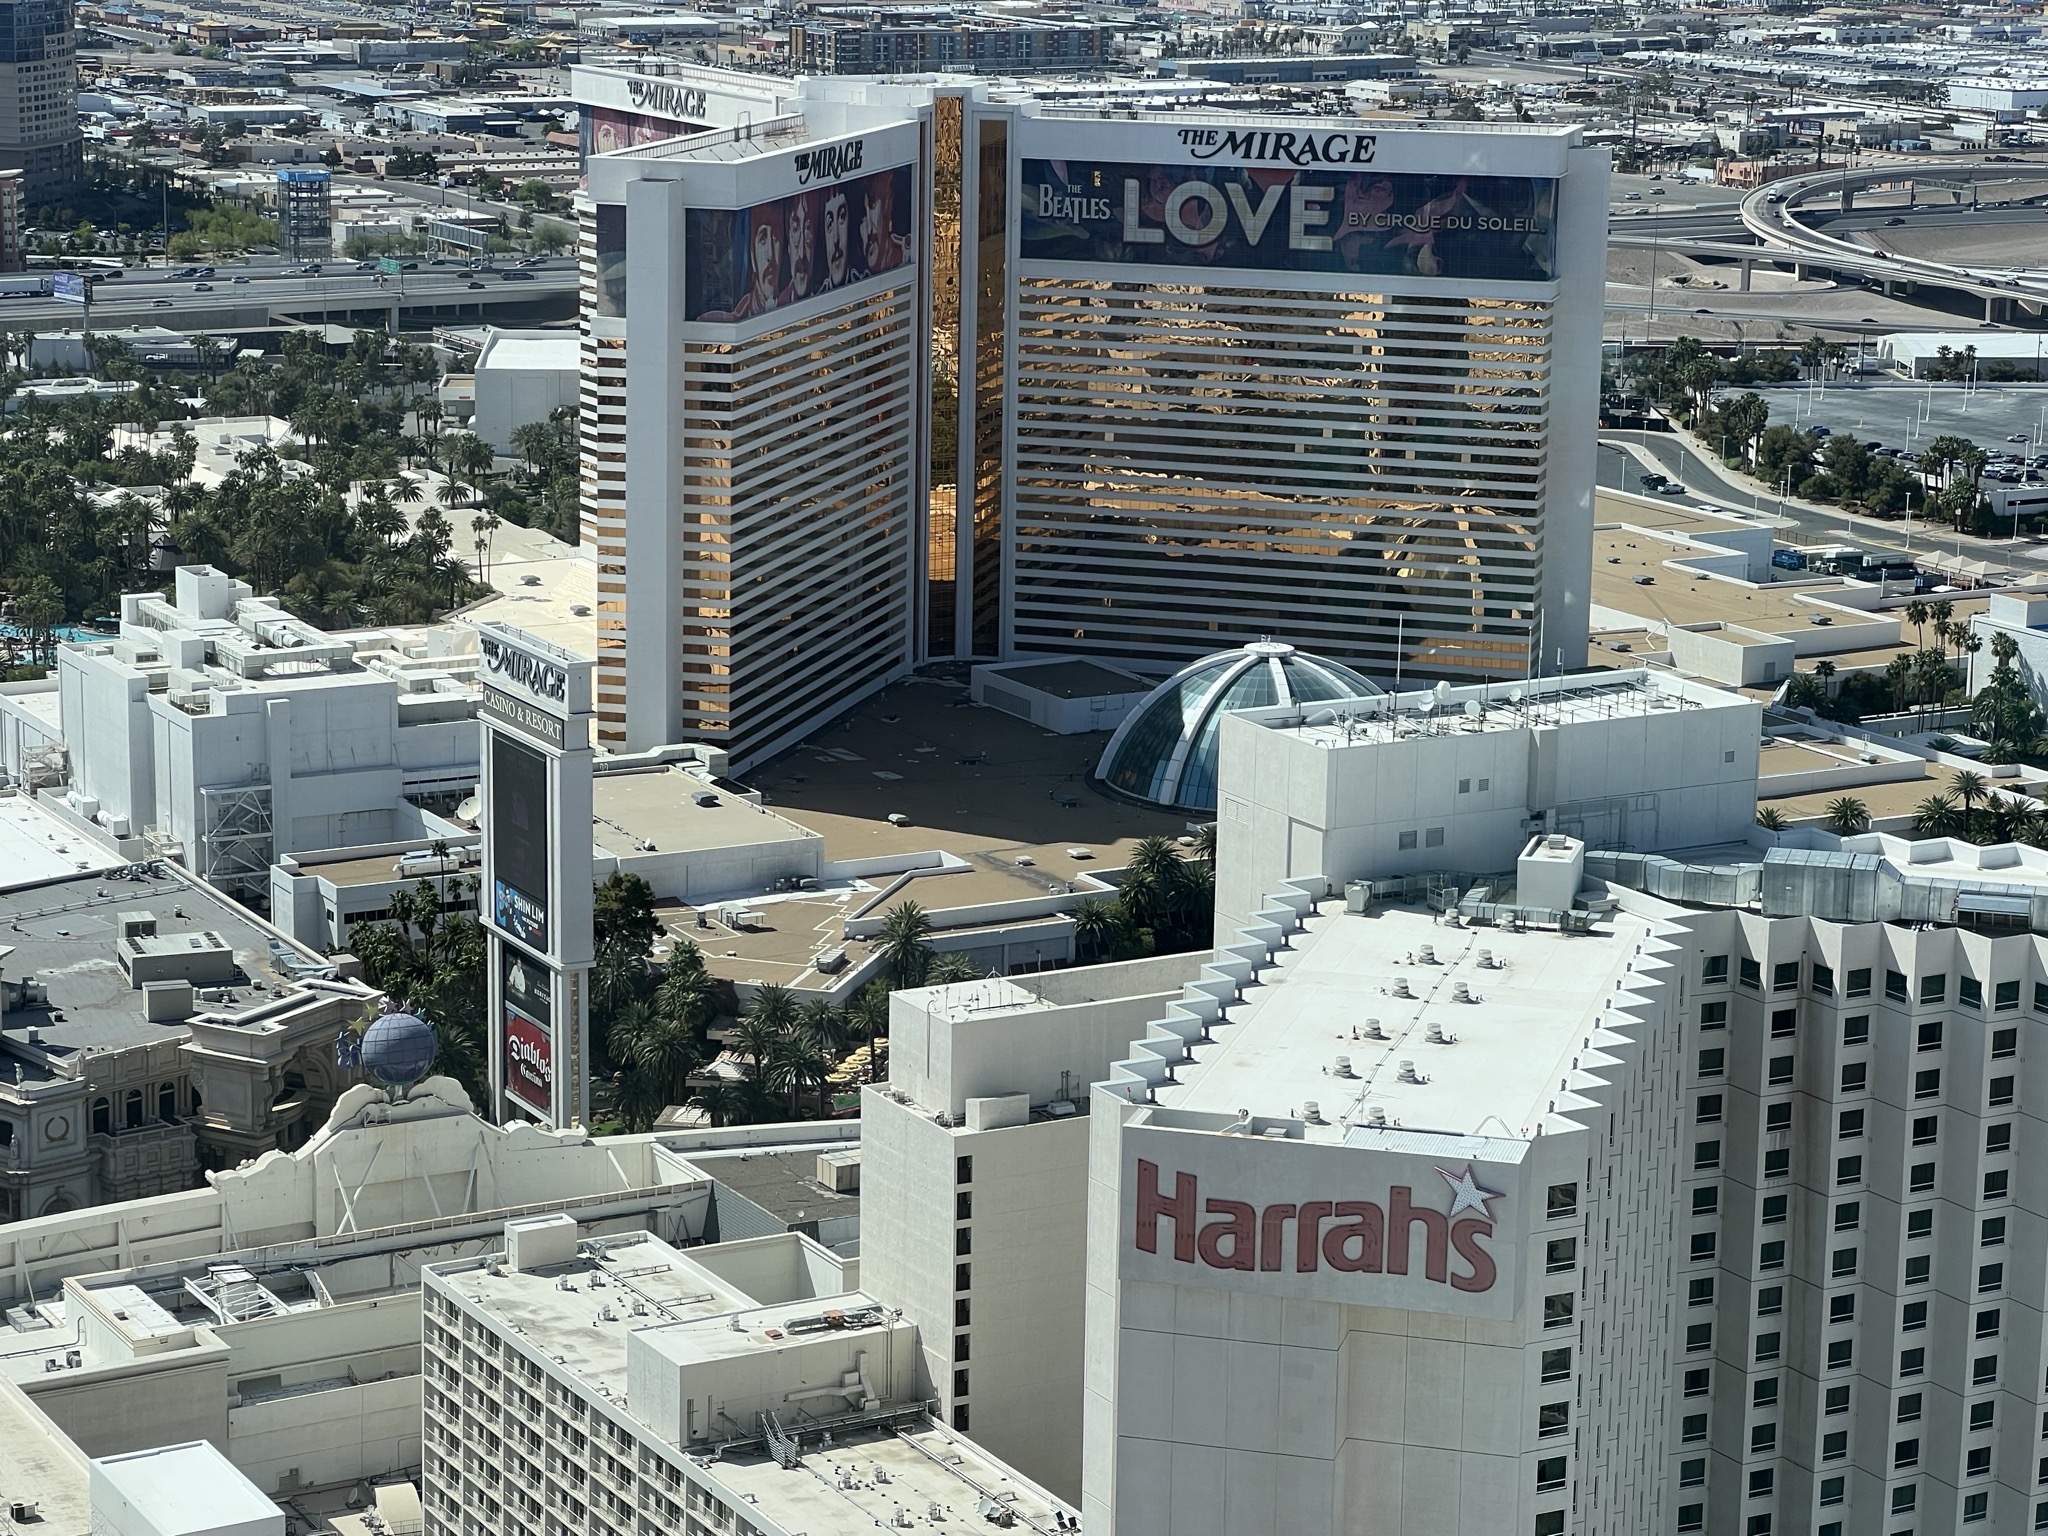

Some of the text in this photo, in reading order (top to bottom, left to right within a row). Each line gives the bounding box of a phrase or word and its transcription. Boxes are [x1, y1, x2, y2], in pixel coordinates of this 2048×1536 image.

[627, 81, 707, 119] THE MIRAGE
[795, 139, 863, 185] THE MIRAGE
[1177, 129, 1377, 166] THE MIRAGE
[1038, 184, 1111, 224] BEATLES
[1067, 184, 1082, 194] THE
[1123, 178, 1335, 251] LOVE
[1348, 212, 1371, 226] BY
[1374, 213, 1441, 233] CIRQUE
[1446, 216, 1473, 230] DU
[480, 638, 565, 704] THE MIRAGE
[484, 690, 562, 740] CASINO & RESORT
[514, 895, 531, 916] SHIN
[531, 904, 544, 925] LIM
